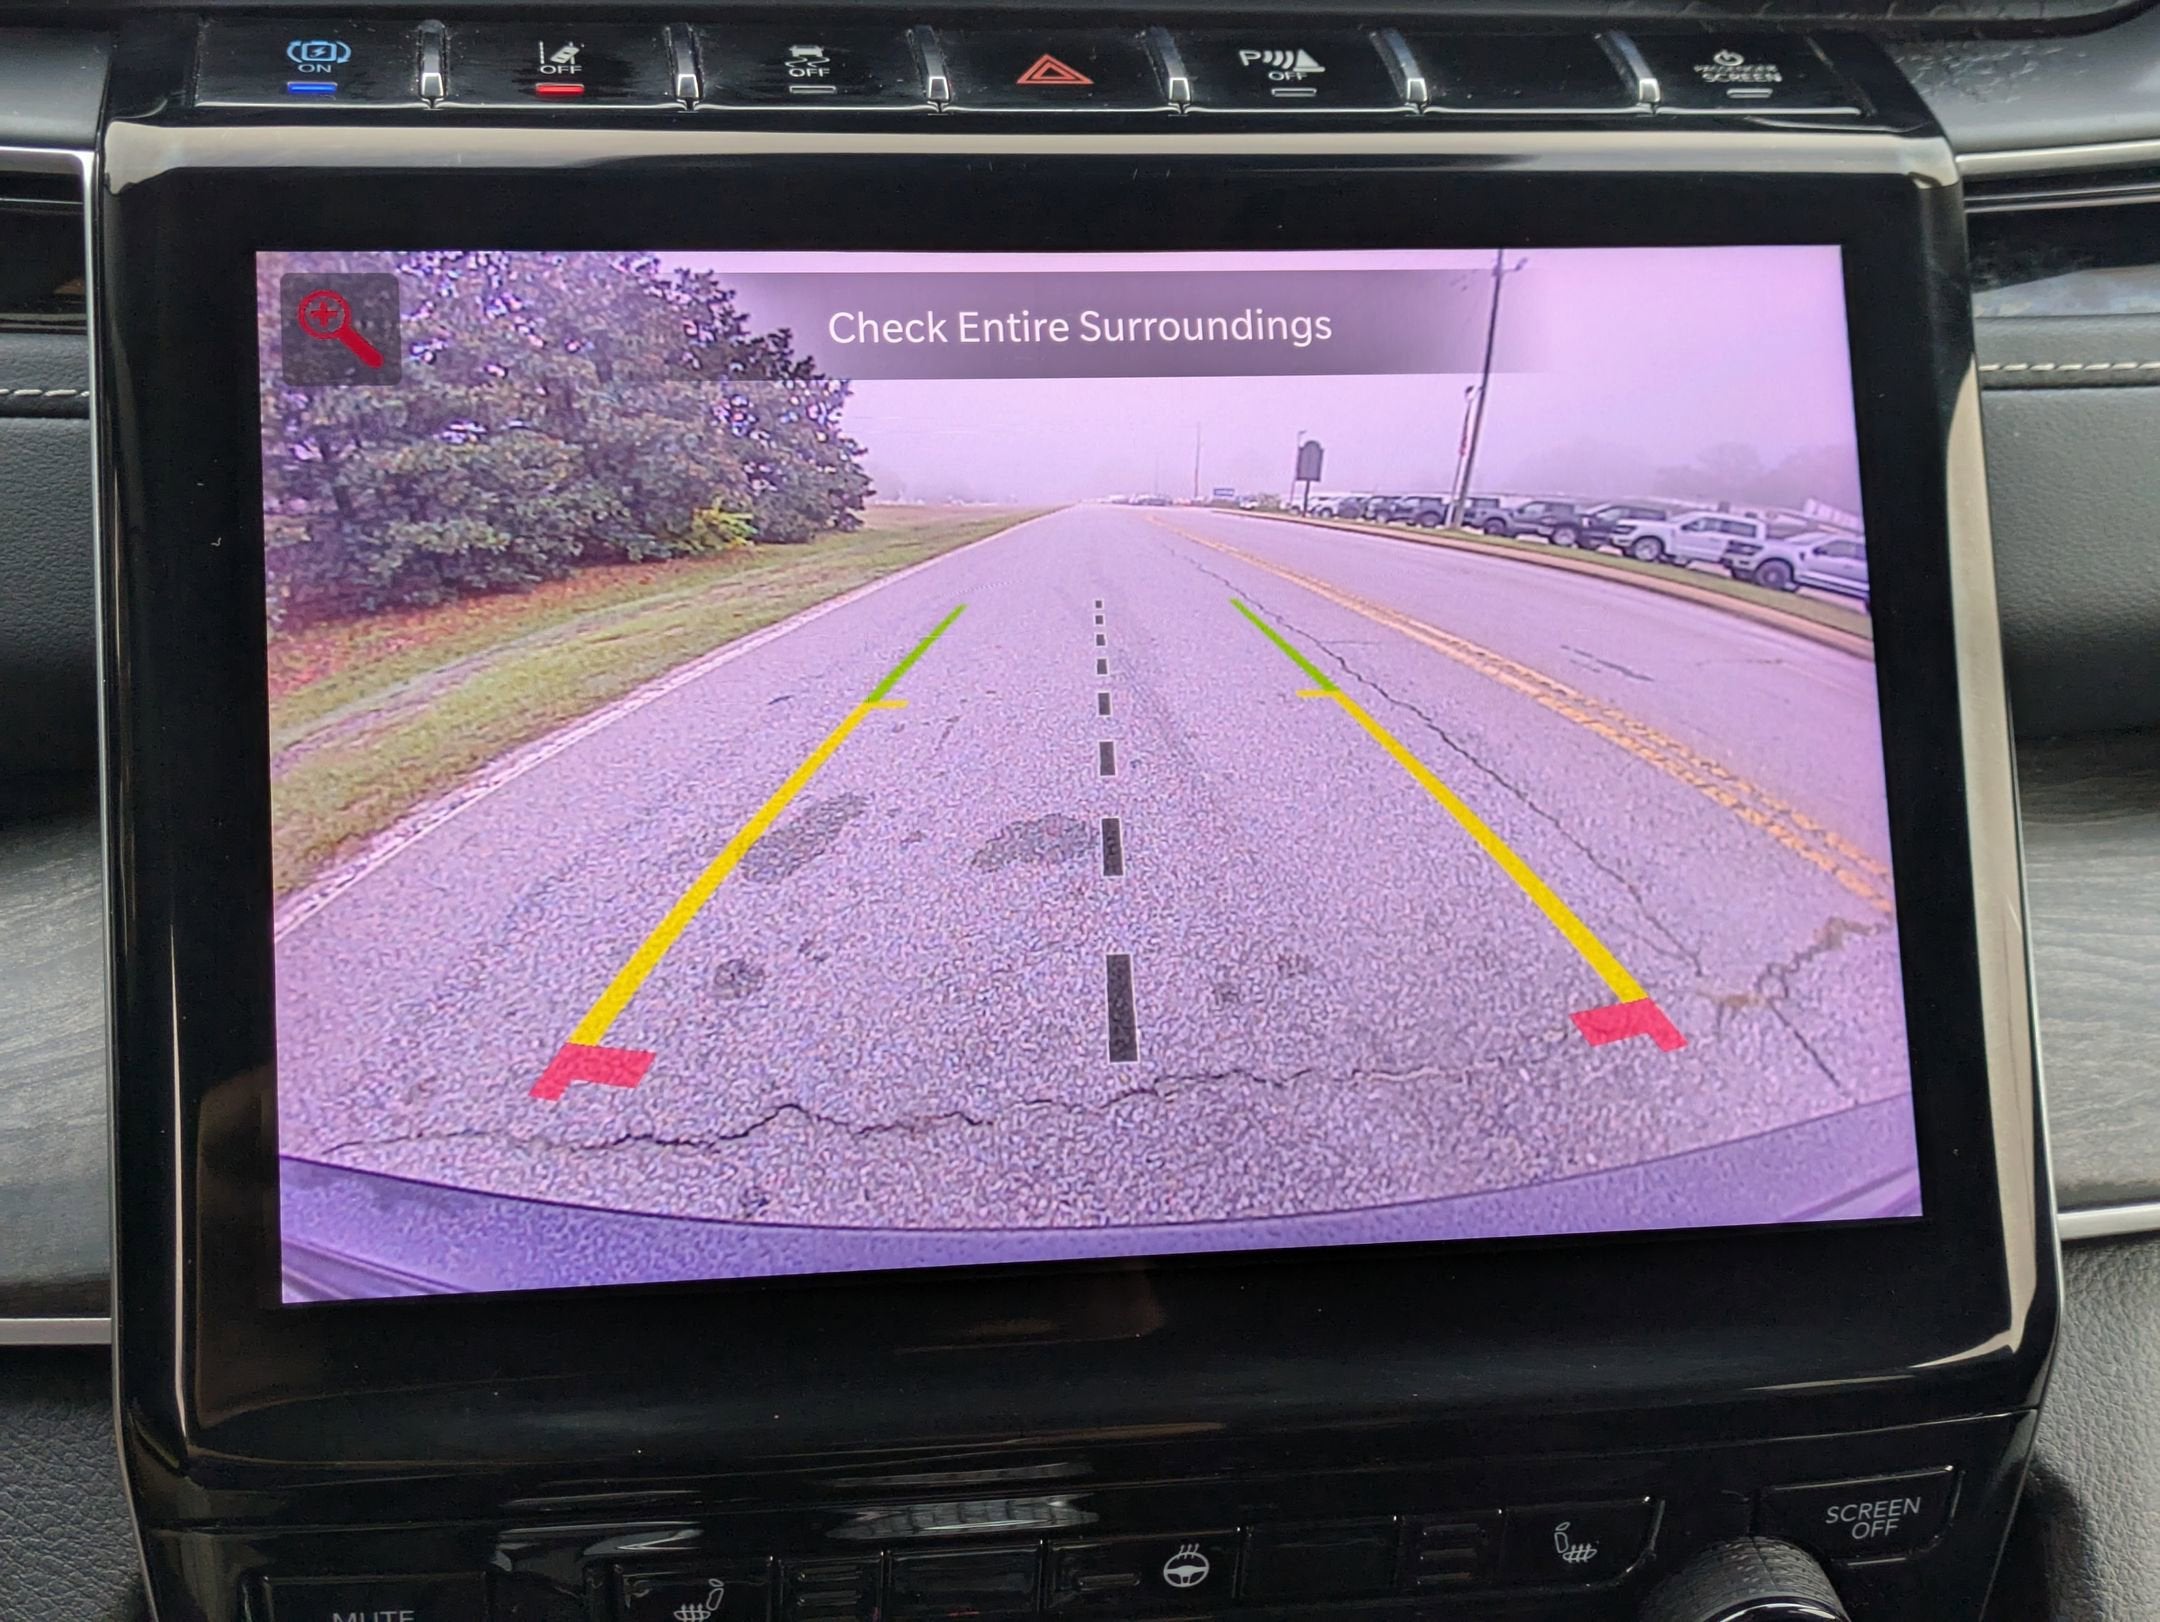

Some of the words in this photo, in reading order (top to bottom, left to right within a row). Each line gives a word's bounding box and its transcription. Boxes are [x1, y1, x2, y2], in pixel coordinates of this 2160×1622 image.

[298, 63, 332, 73] ON
[540, 64, 582, 75] OFF
[788, 67, 831, 78] OFF
[1268, 70, 1308, 81] OFF
[828, 310, 949, 343] Check
[958, 309, 1070, 343] Entire
[1079, 308, 1333, 348] Surroundings
[1825, 1496, 1922, 1524] SCREEN
[1851, 1518, 1900, 1540] OFF
